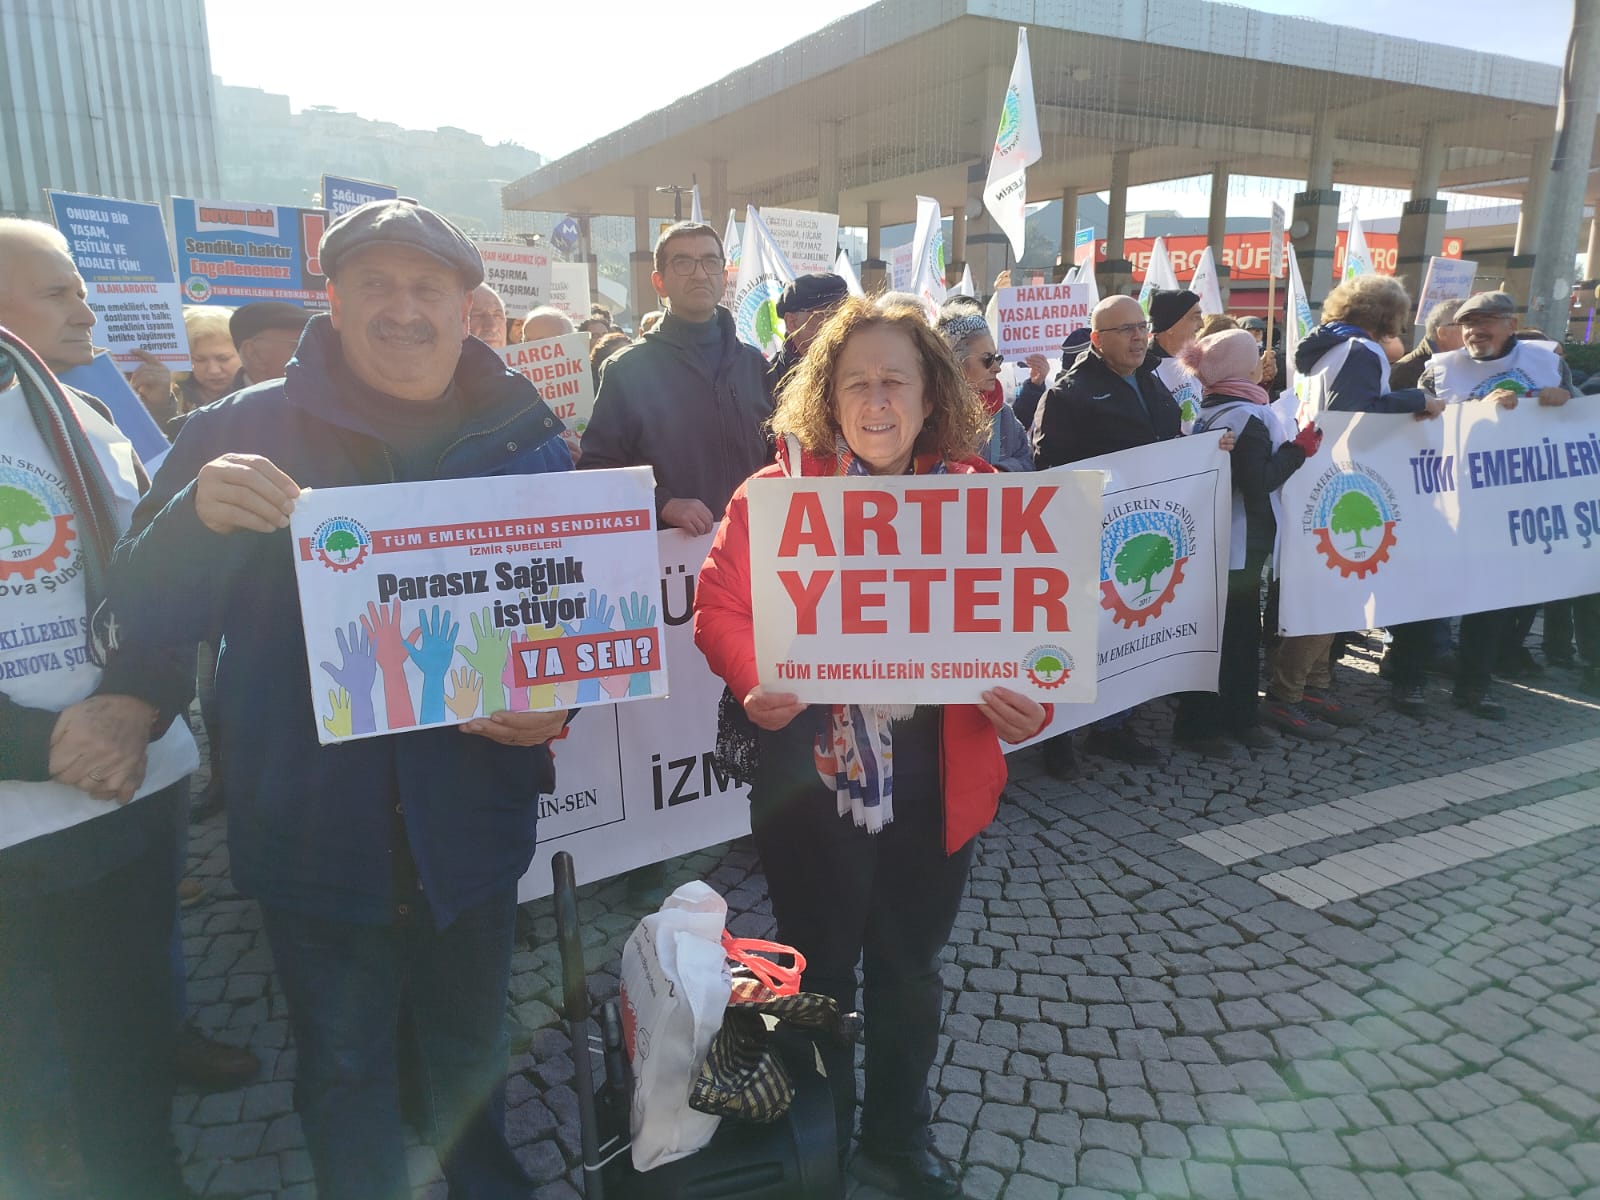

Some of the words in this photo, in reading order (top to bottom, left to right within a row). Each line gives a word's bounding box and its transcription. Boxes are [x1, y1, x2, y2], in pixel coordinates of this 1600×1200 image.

[66, 208, 109, 222] ONURLU
[110, 211, 130, 224] BİR
[70, 224, 110, 240] YAŞAM,
[562, 224, 578, 234] M
[74, 238, 112, 254] EŞİTLİK
[112, 244, 127, 255] VE
[186, 238, 245, 256] Sendika
[248, 242, 292, 259] haktır
[79, 257, 116, 270] ADALET
[118, 258, 141, 273] İÇİN!
[190, 258, 290, 279] Engellenemez
[488, 268, 528, 281] ŞAŞIRMA
[96, 284, 158, 294] ALANLARDAYIZ
[498, 284, 540, 297] TAŞIRMA!
[1016, 286, 1071, 302] HAKLAR
[150, 302, 169, 310] emek
[999, 304, 1088, 322] YASALARDAN
[108, 324, 145, 332] emeklinin
[146, 322, 174, 332] isyanını
[1003, 325, 1040, 342] ÖNCE
[108, 334, 135, 342] birlikte
[137, 332, 176, 342] büyütmeye
[506, 343, 564, 367] LARCA
[1410, 450, 1455, 494] TÜM
[1468, 432, 1600, 490] EMEKLİLERİ
[778, 486, 1060, 558] ARTIK
[1101, 498, 1160, 529] KLİLERİN
[1164, 500, 1196, 556] SENDİKASI
[1303, 504, 1314, 534] TÜM
[382, 532, 422, 548] TÜM
[429, 522, 544, 543] EMEKLİLERİN
[551, 515, 640, 533] SENDİKASI
[1508, 505, 1568, 554] FOÇA
[12, 548, 32, 558] 2017
[470, 545, 502, 556] İZMİR
[505, 540, 562, 555] ŞUBELERİ
[378, 568, 489, 602] Parasız
[494, 556, 584, 595] Sağlık
[776, 567, 1071, 635] YETER
[494, 596, 587, 629] istiyor
[1110, 622, 1198, 662] EMEKLİLERİN-SEN
[520, 645, 565, 680] YA
[576, 636, 652, 672] SEN?
[776, 662, 811, 681] TÜM
[817, 660, 925, 680] EMEKLİLERİN
[930, 658, 1018, 680] SENDİKASI
[538, 788, 598, 819] İN-SEN
